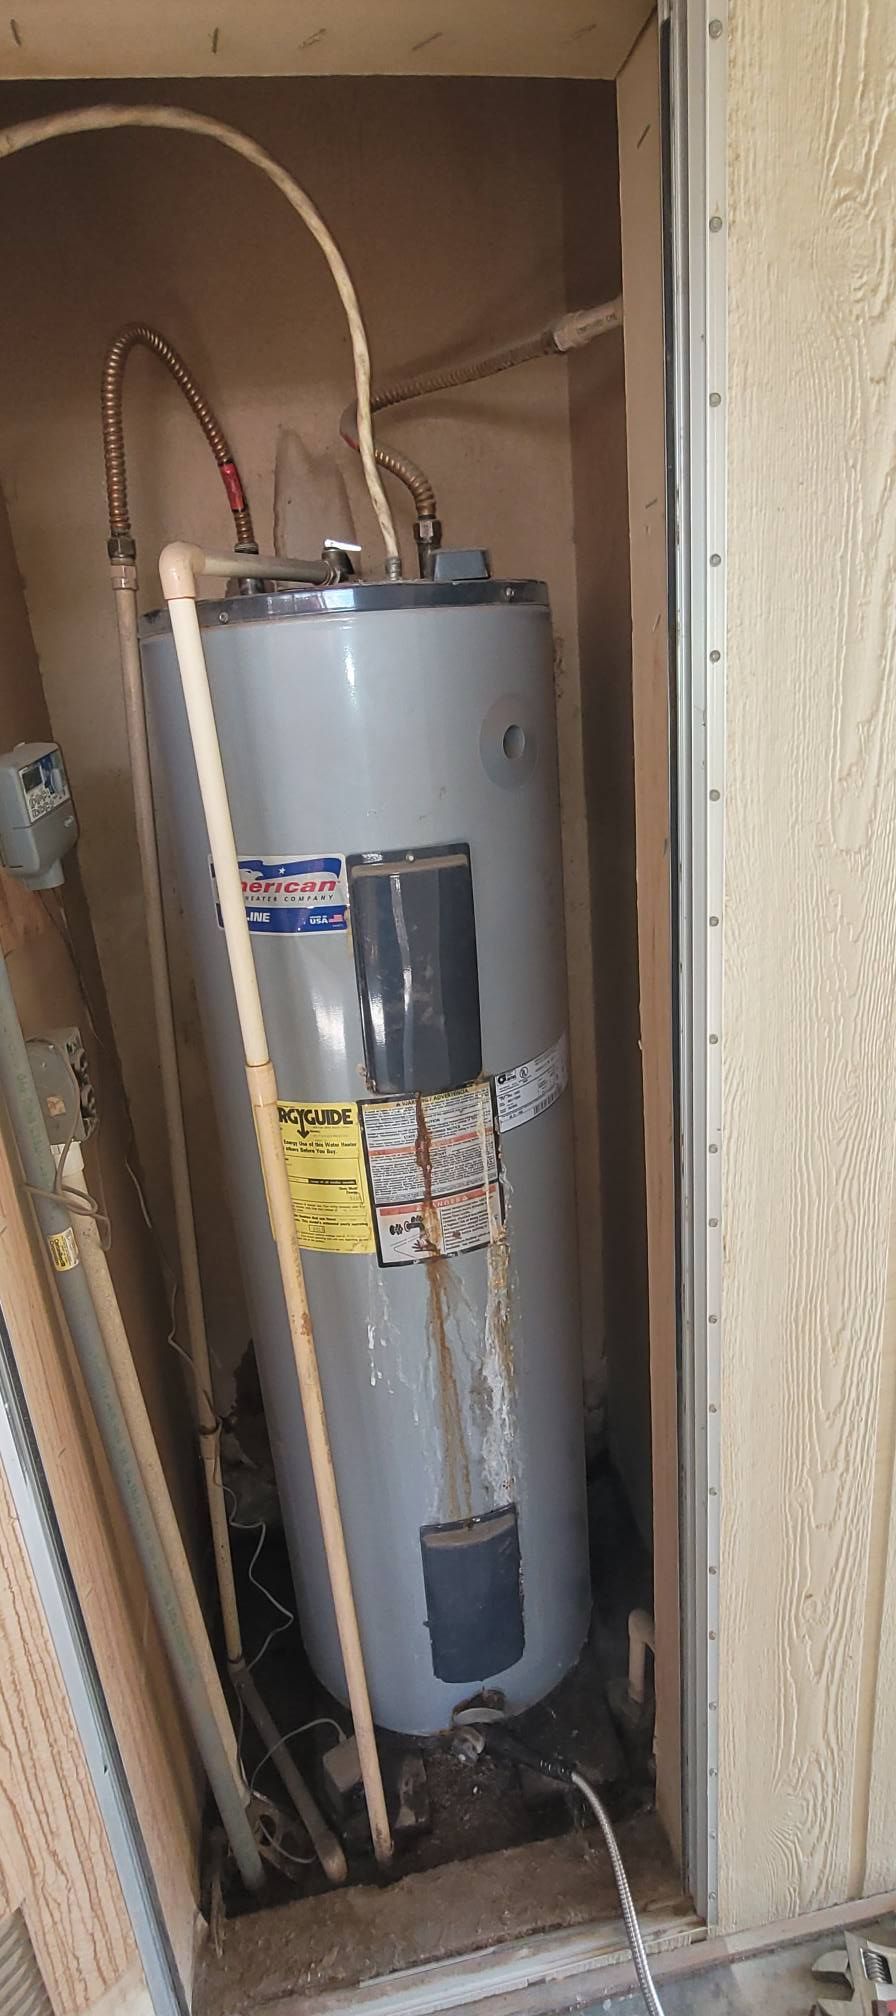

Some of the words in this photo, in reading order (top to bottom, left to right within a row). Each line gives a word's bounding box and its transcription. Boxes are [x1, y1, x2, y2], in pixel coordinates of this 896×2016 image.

[241, 881, 337, 893] erican
[284, 894, 334, 902] COMPANY
[278, 1107, 353, 1126] RGYGUIDE
